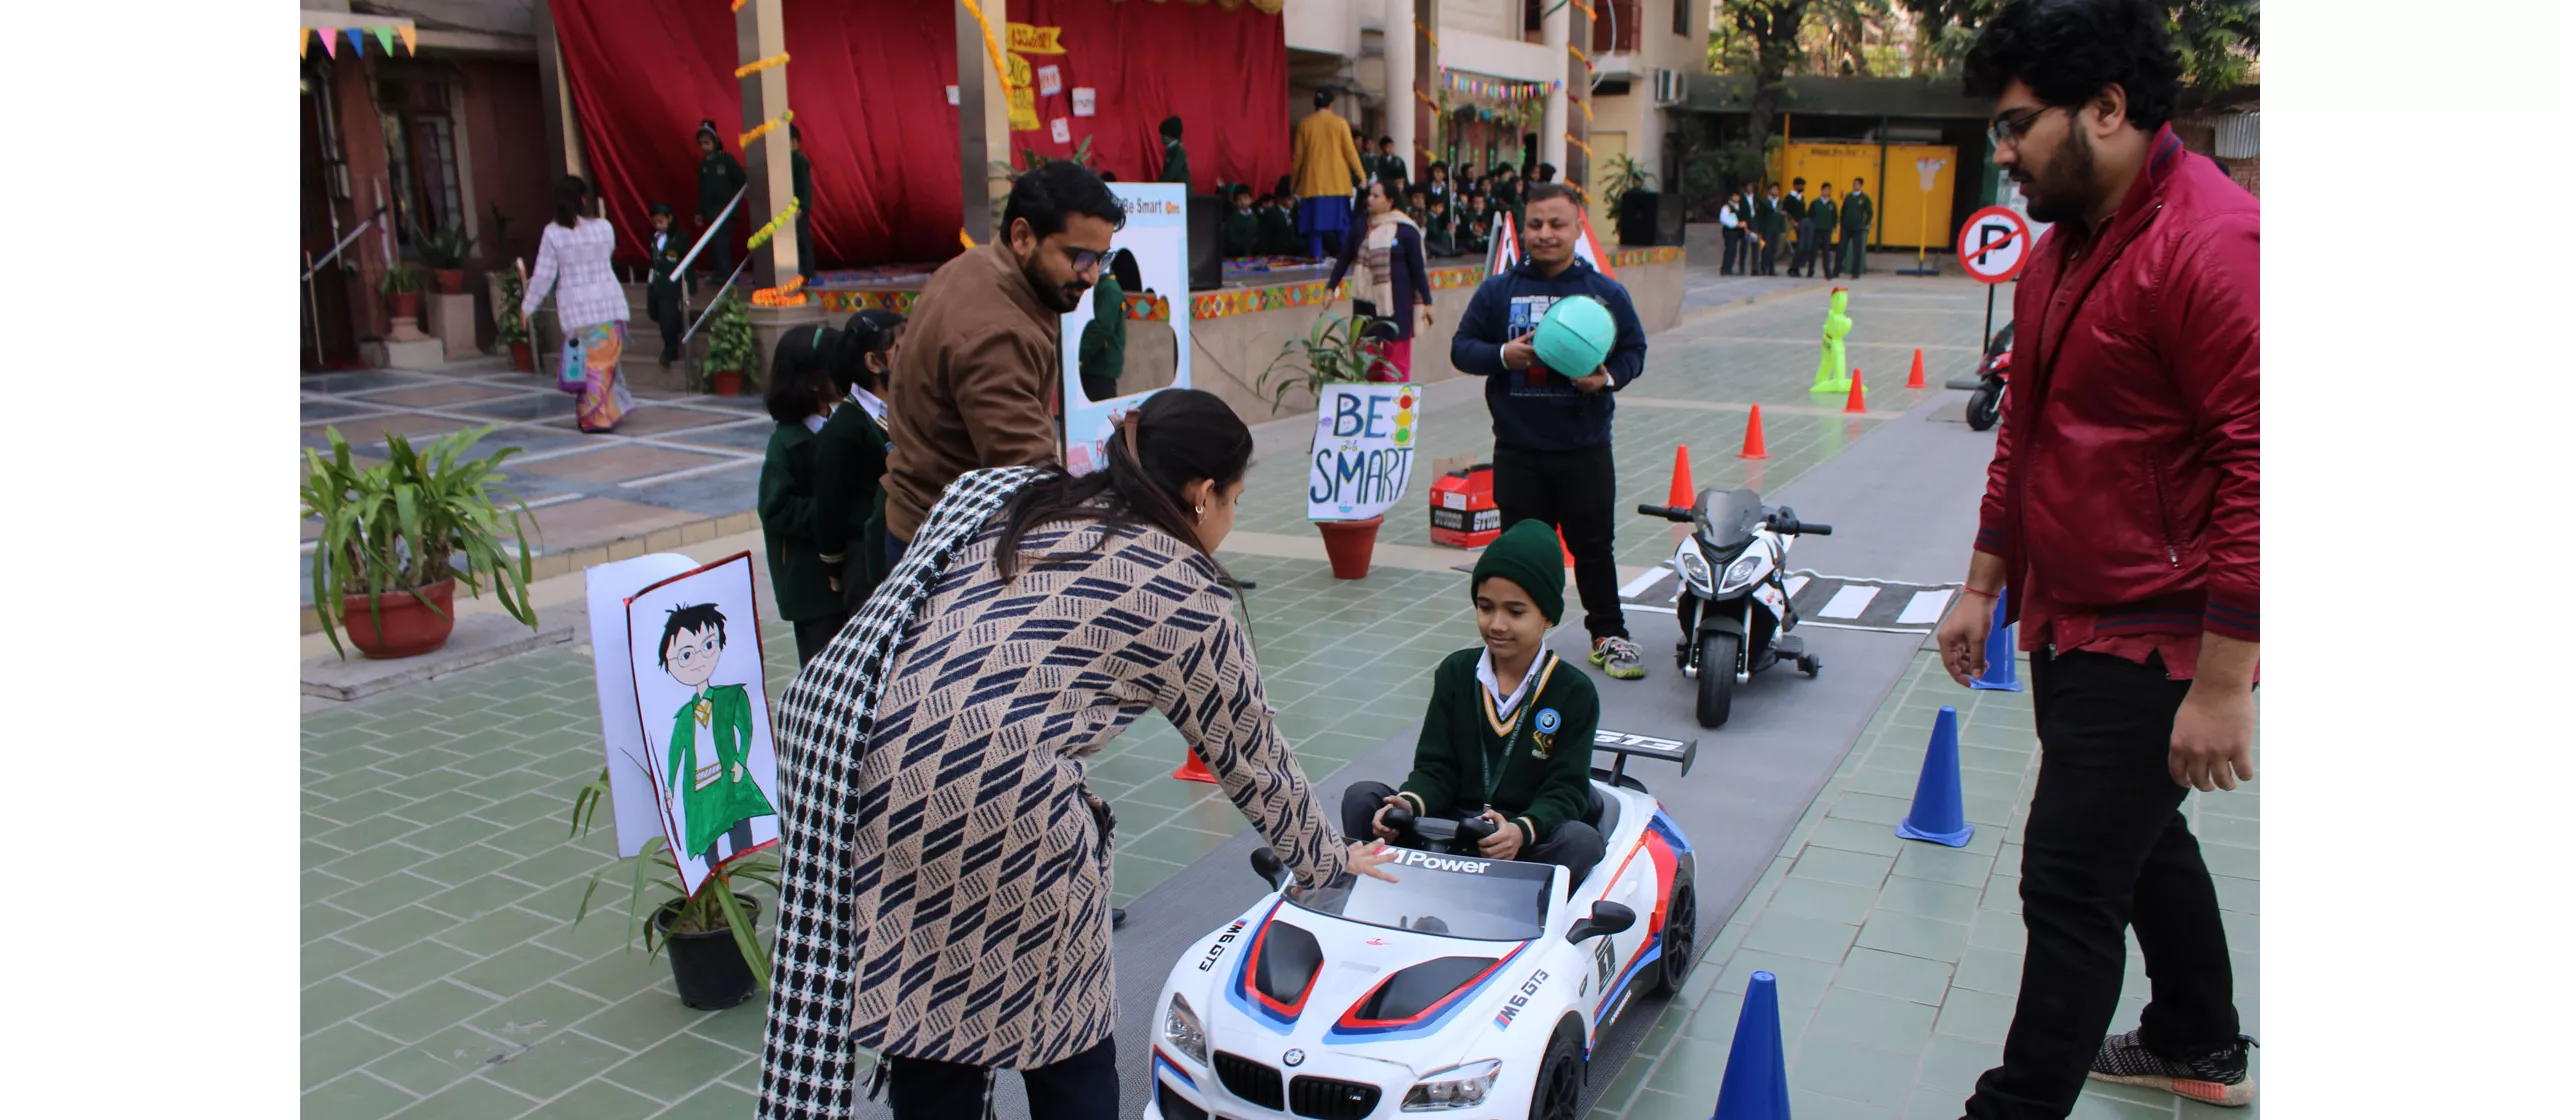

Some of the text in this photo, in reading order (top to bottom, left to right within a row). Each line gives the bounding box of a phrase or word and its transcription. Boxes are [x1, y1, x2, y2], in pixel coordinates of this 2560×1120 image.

[1124, 198, 1134, 214] Be
[1137, 198, 1162, 214] Smart
[1978, 224, 2012, 265] P
[1333, 393, 1391, 438] BE
[1310, 447, 1413, 504] SMART
[1406, 852, 1491, 874] Power
[1199, 944, 1225, 972] GT3
[1499, 968, 1549, 1022] M6 GT3
